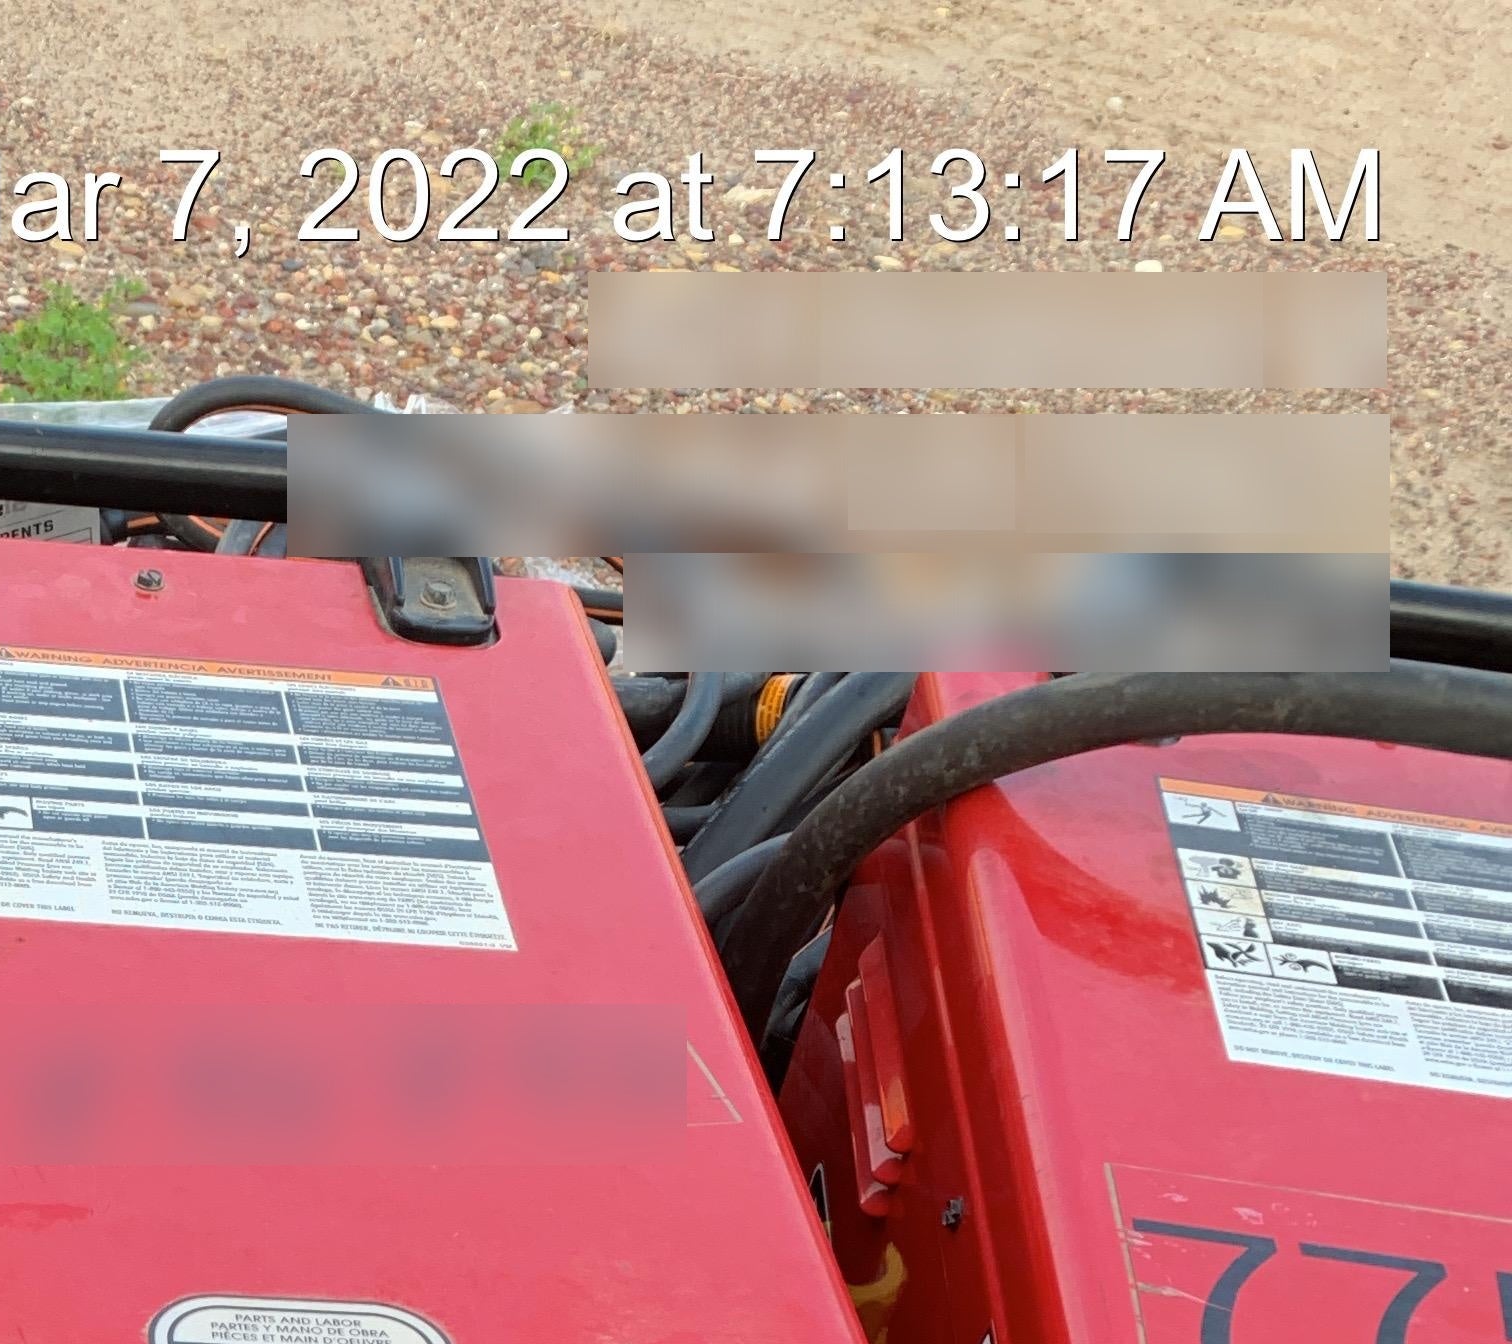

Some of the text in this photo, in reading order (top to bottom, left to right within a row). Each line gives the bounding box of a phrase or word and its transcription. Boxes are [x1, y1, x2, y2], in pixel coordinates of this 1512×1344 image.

[235, 1313, 361, 1328] PARTS AND LABOR
[276, 1325, 323, 1336] MANO
[327, 1327, 345, 1336] DE
[349, 1328, 389, 1339] OBRA
